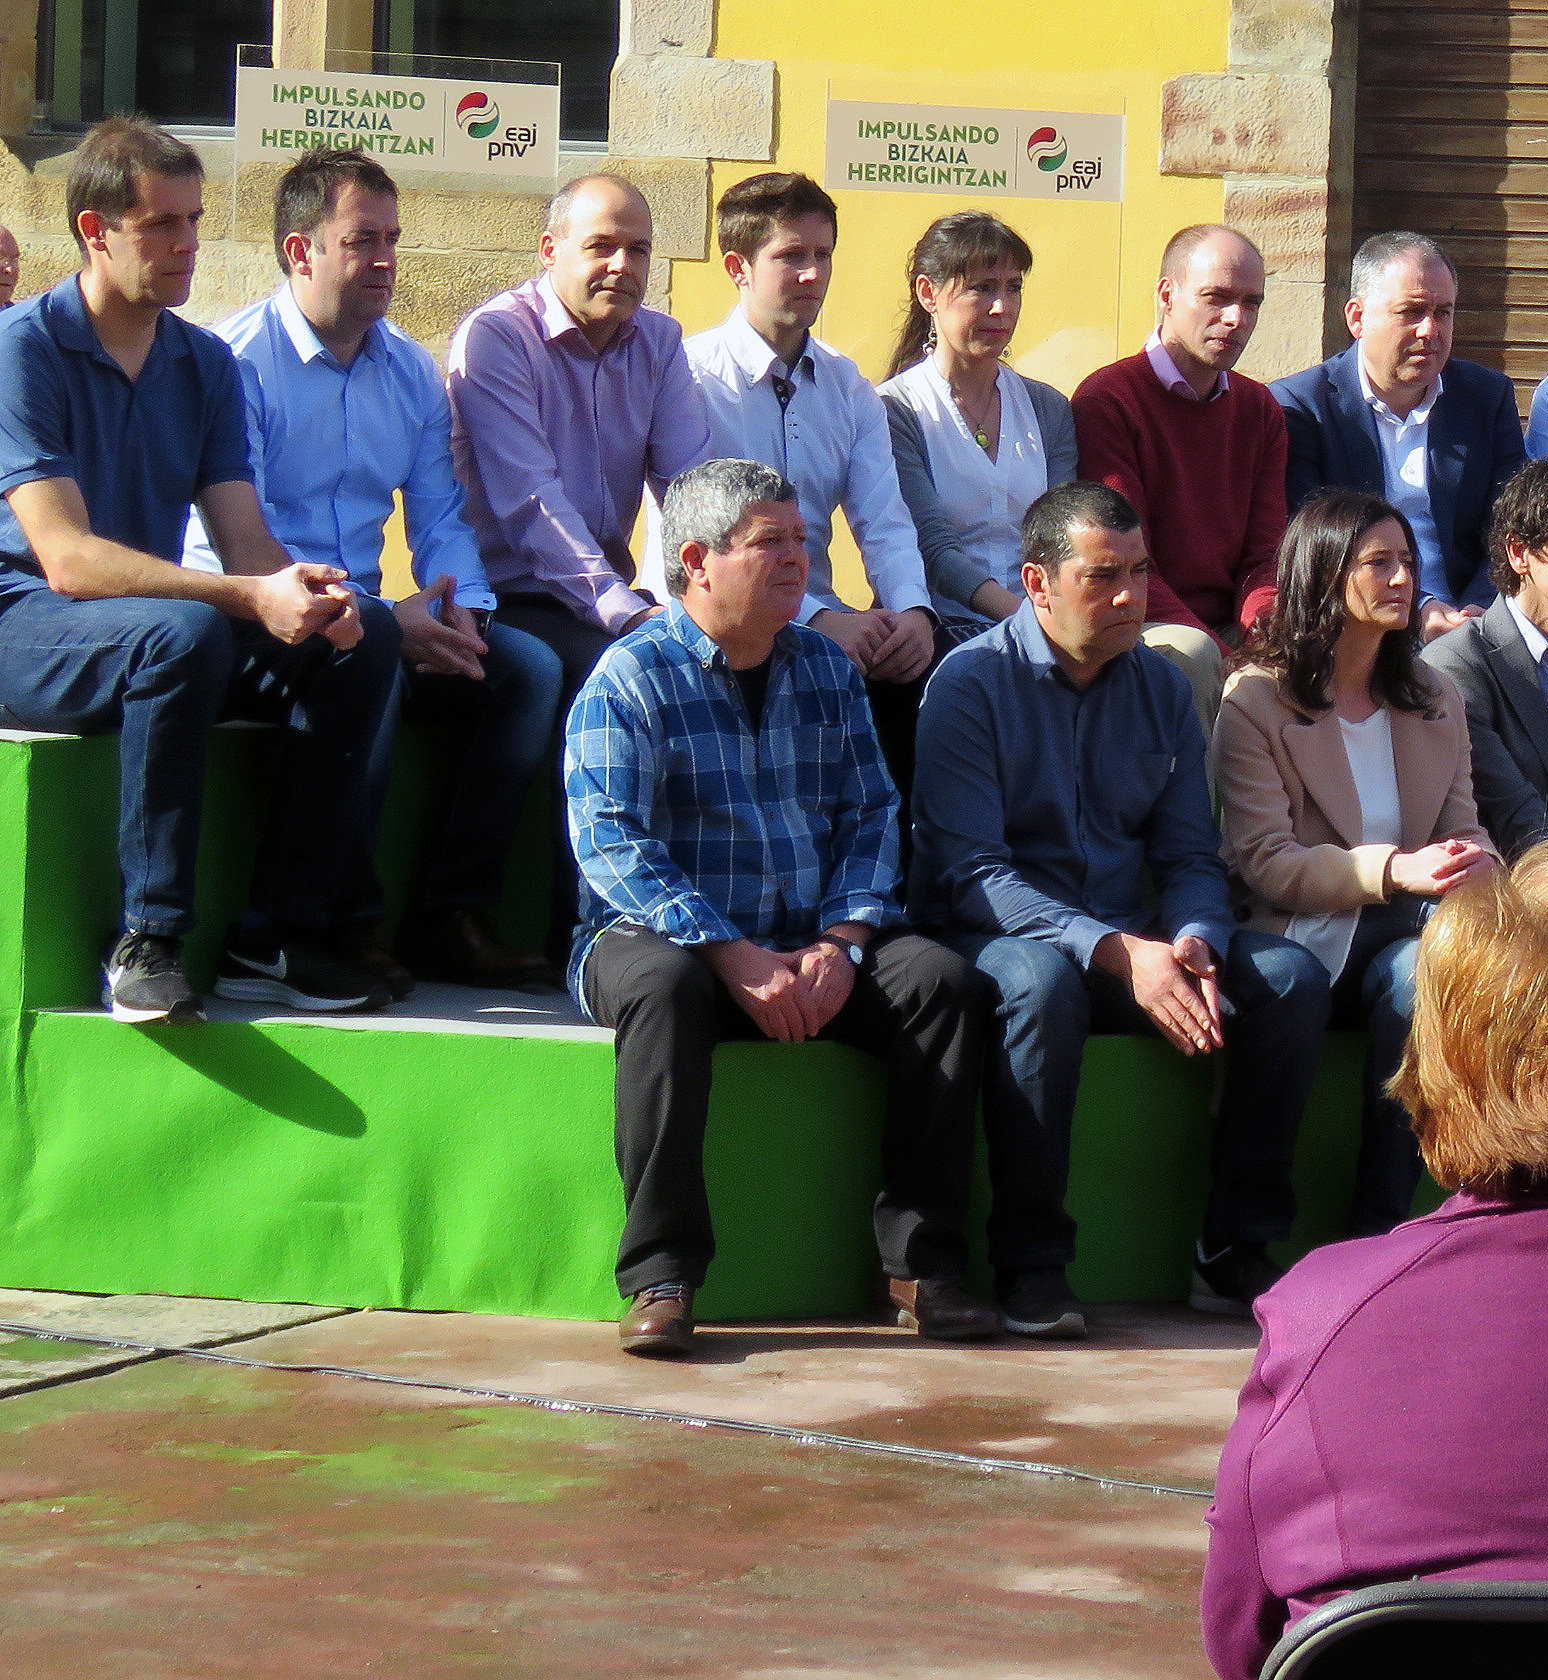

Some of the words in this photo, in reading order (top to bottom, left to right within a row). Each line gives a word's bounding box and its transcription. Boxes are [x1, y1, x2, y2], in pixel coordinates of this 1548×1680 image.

[272, 83, 426, 111] IMPULSANDO
[304, 108, 392, 131] BIZKAIA
[505, 123, 537, 147] eaj
[857, 119, 1000, 145] IMPULSANDO
[487, 141, 529, 161] pnv
[887, 143, 969, 165] BIZKAIA
[847, 162, 1007, 188] HERRIGINTZAN
[1072, 156, 1102, 180] eaj
[1056, 174, 1094, 193] pnv
